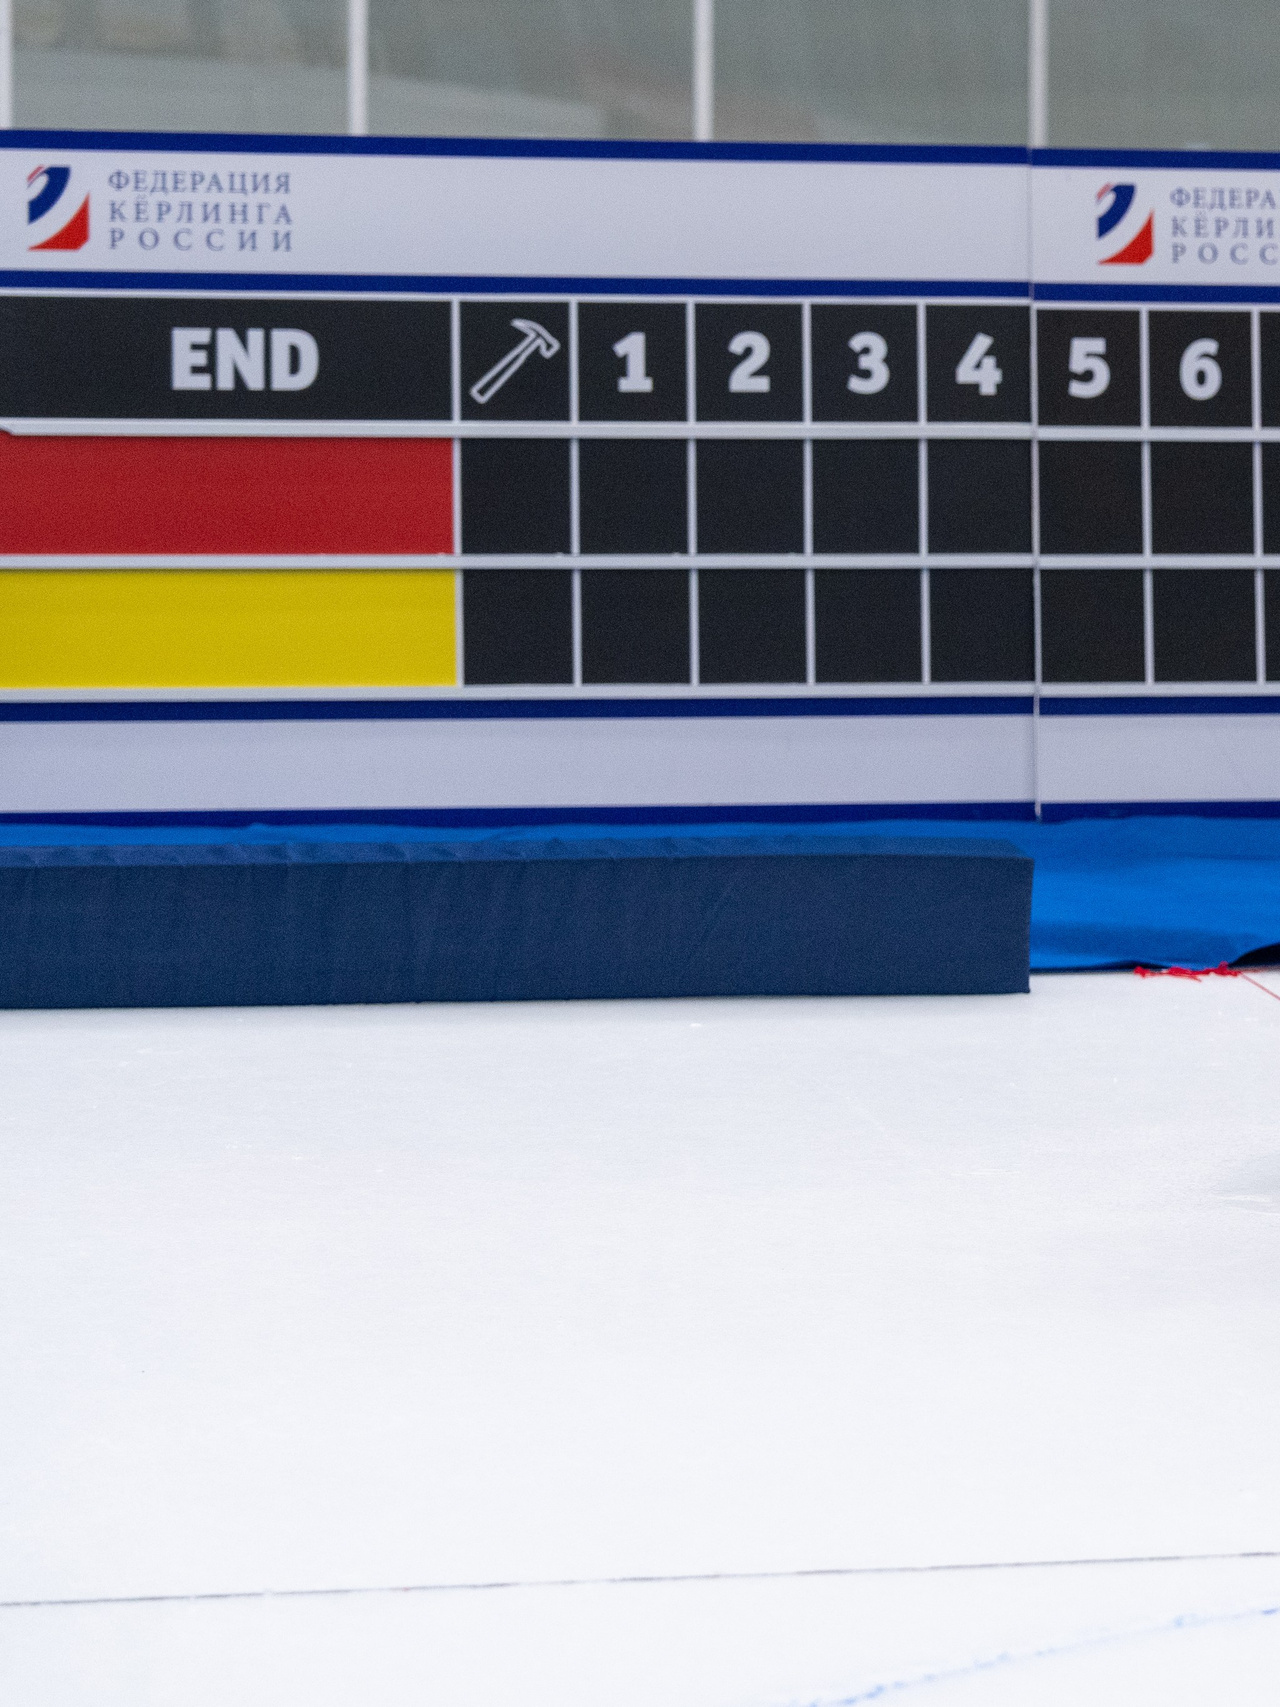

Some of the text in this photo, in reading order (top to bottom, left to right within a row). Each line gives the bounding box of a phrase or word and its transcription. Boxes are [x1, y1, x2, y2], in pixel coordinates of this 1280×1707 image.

[108, 169, 291, 196] ФЕДЕРАЦИЯ
[108, 194, 293, 226] КЁРЛИНГА
[109, 227, 292, 253] РОССИИ
[171, 327, 319, 391] END
[613, 332, 653, 393] 1
[728, 331, 770, 393] 2
[848, 332, 890, 394] 3
[956, 333, 1002, 396] 4
[1068, 337, 1110, 398] 5
[1180, 338, 1222, 400] 6
